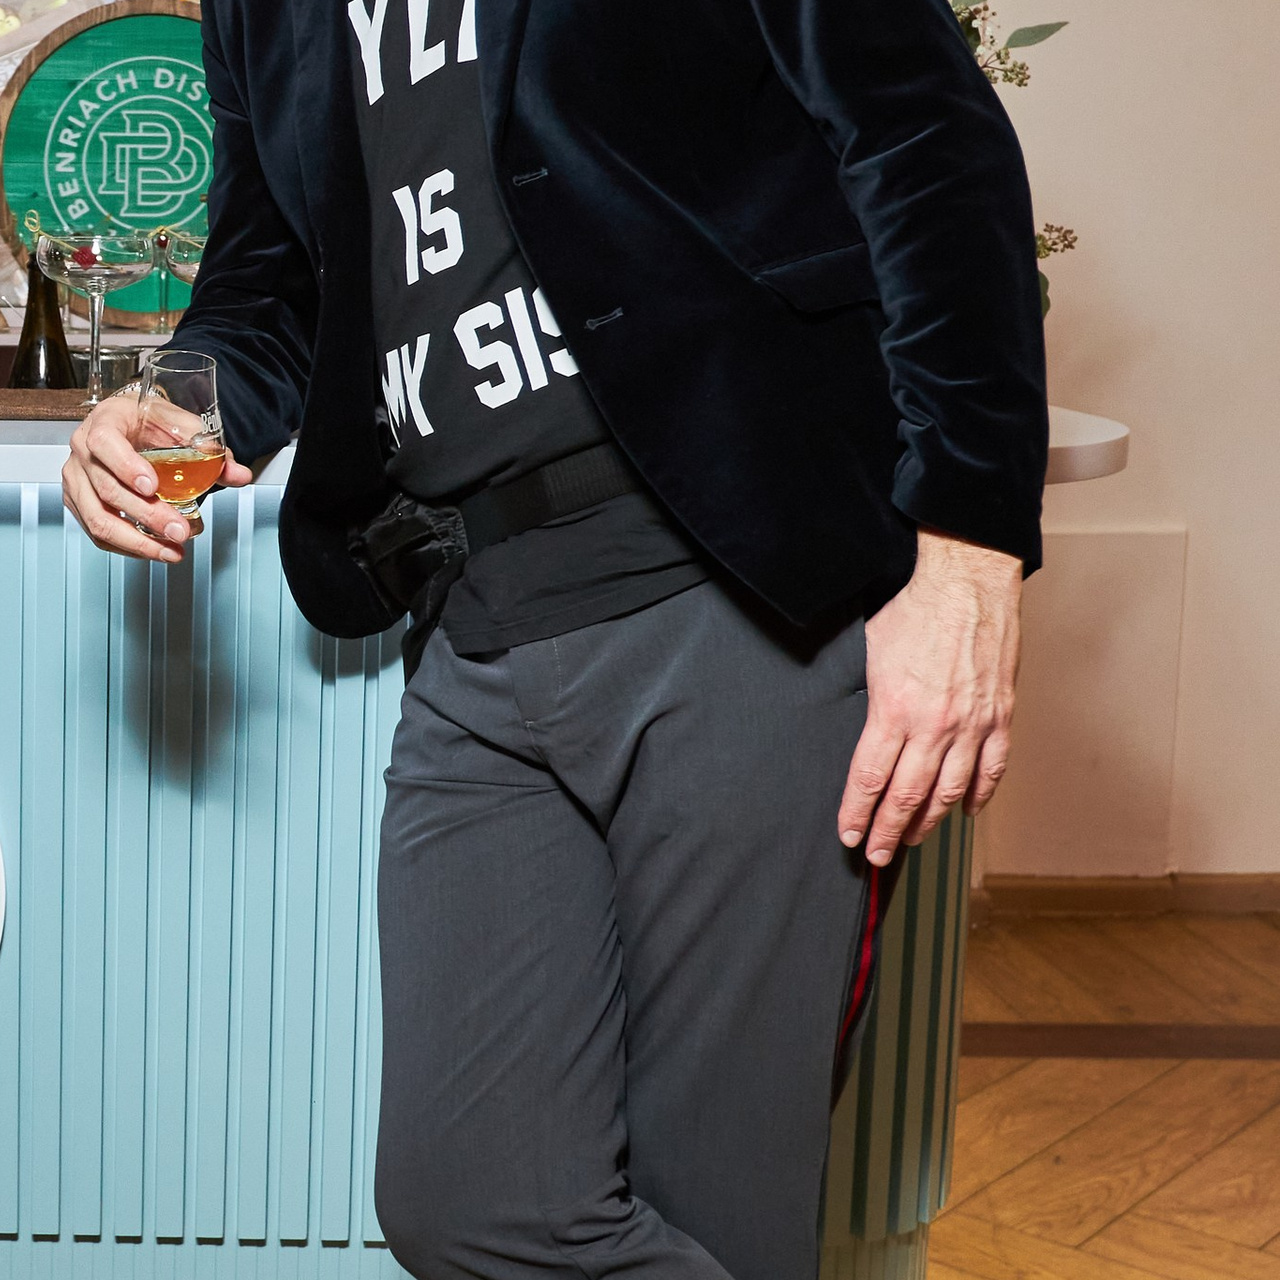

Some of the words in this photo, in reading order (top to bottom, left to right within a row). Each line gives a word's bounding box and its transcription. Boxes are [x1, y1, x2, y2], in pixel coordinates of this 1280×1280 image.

[55, 70, 139, 220] BENRIACH
[153, 67, 209, 111] DIS
[392, 168, 464, 286] IS
[382, 333, 434, 448] MY
